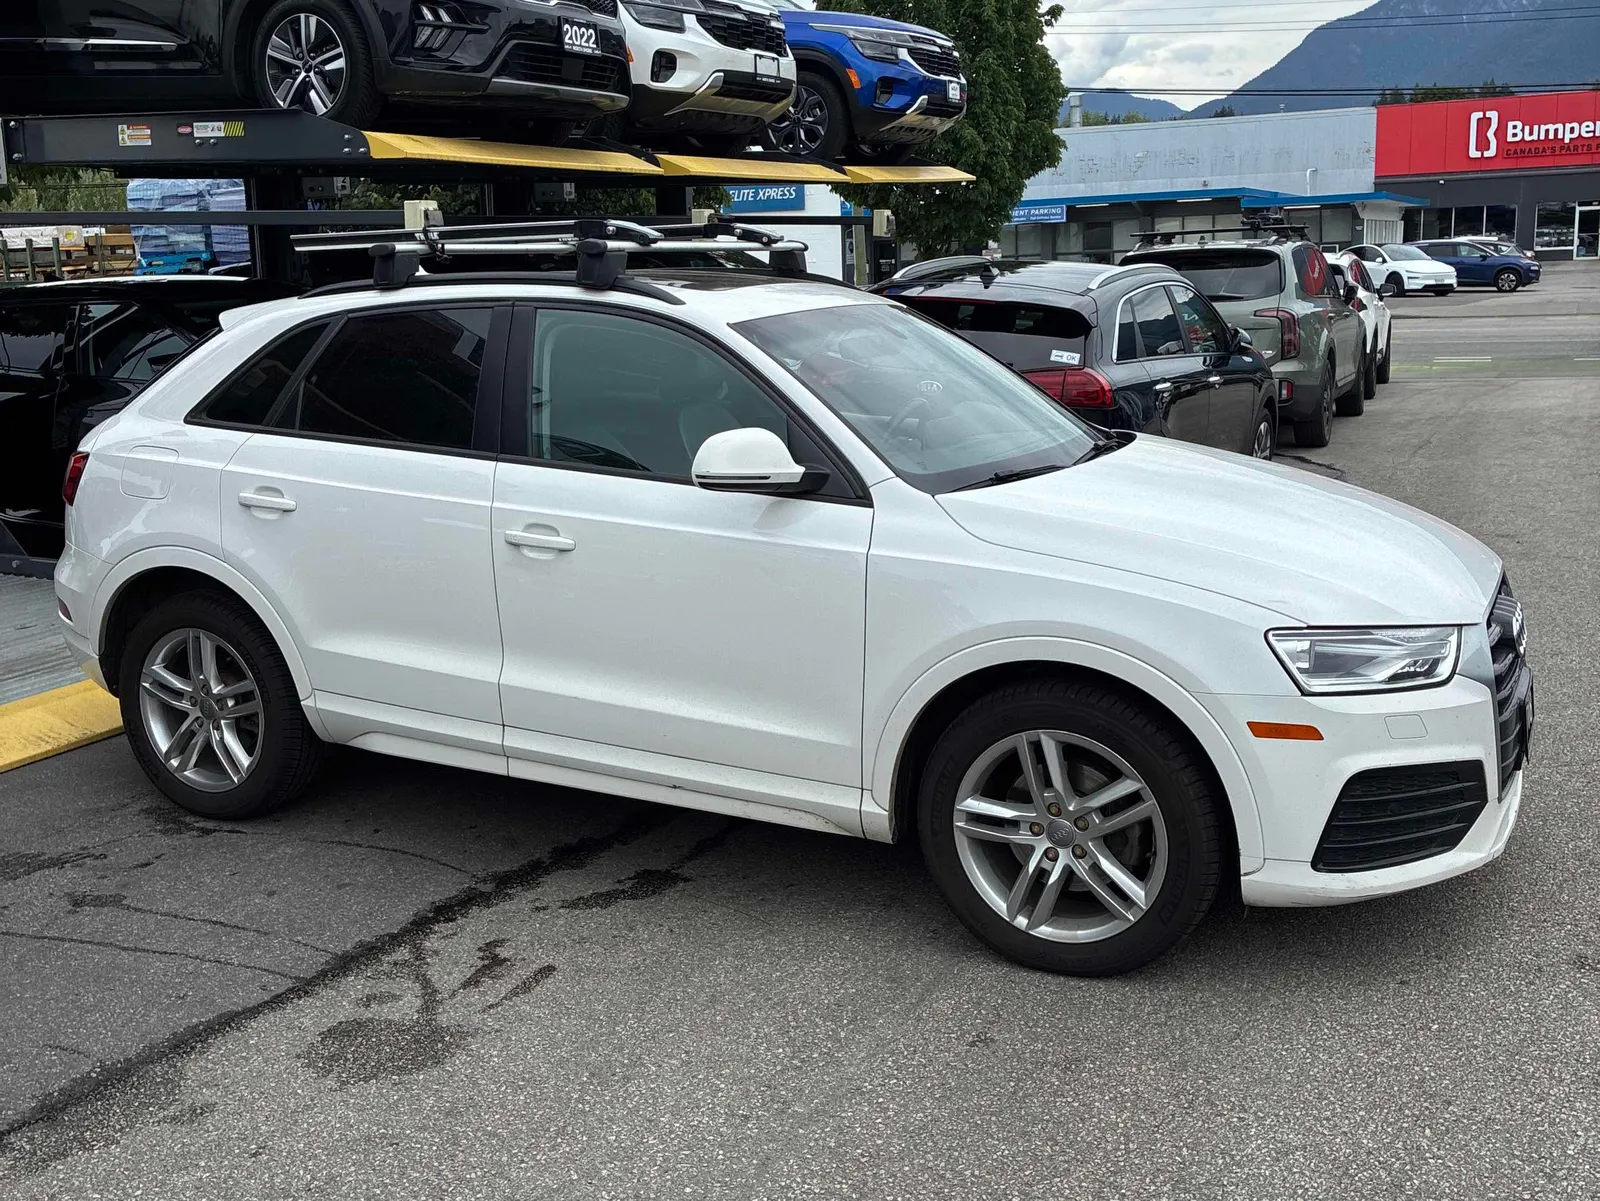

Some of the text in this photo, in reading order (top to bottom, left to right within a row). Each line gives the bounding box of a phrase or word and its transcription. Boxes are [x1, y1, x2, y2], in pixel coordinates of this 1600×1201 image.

[564, 24, 596, 48] 2022
[1506, 120, 1600, 143] Bumper
[1505, 146, 1557, 157] CANADA'S
[1559, 143, 1593, 153] PARTS
[729, 187, 797, 202] ELITE XPRESS
[1066, 354, 1077, 362] OK
